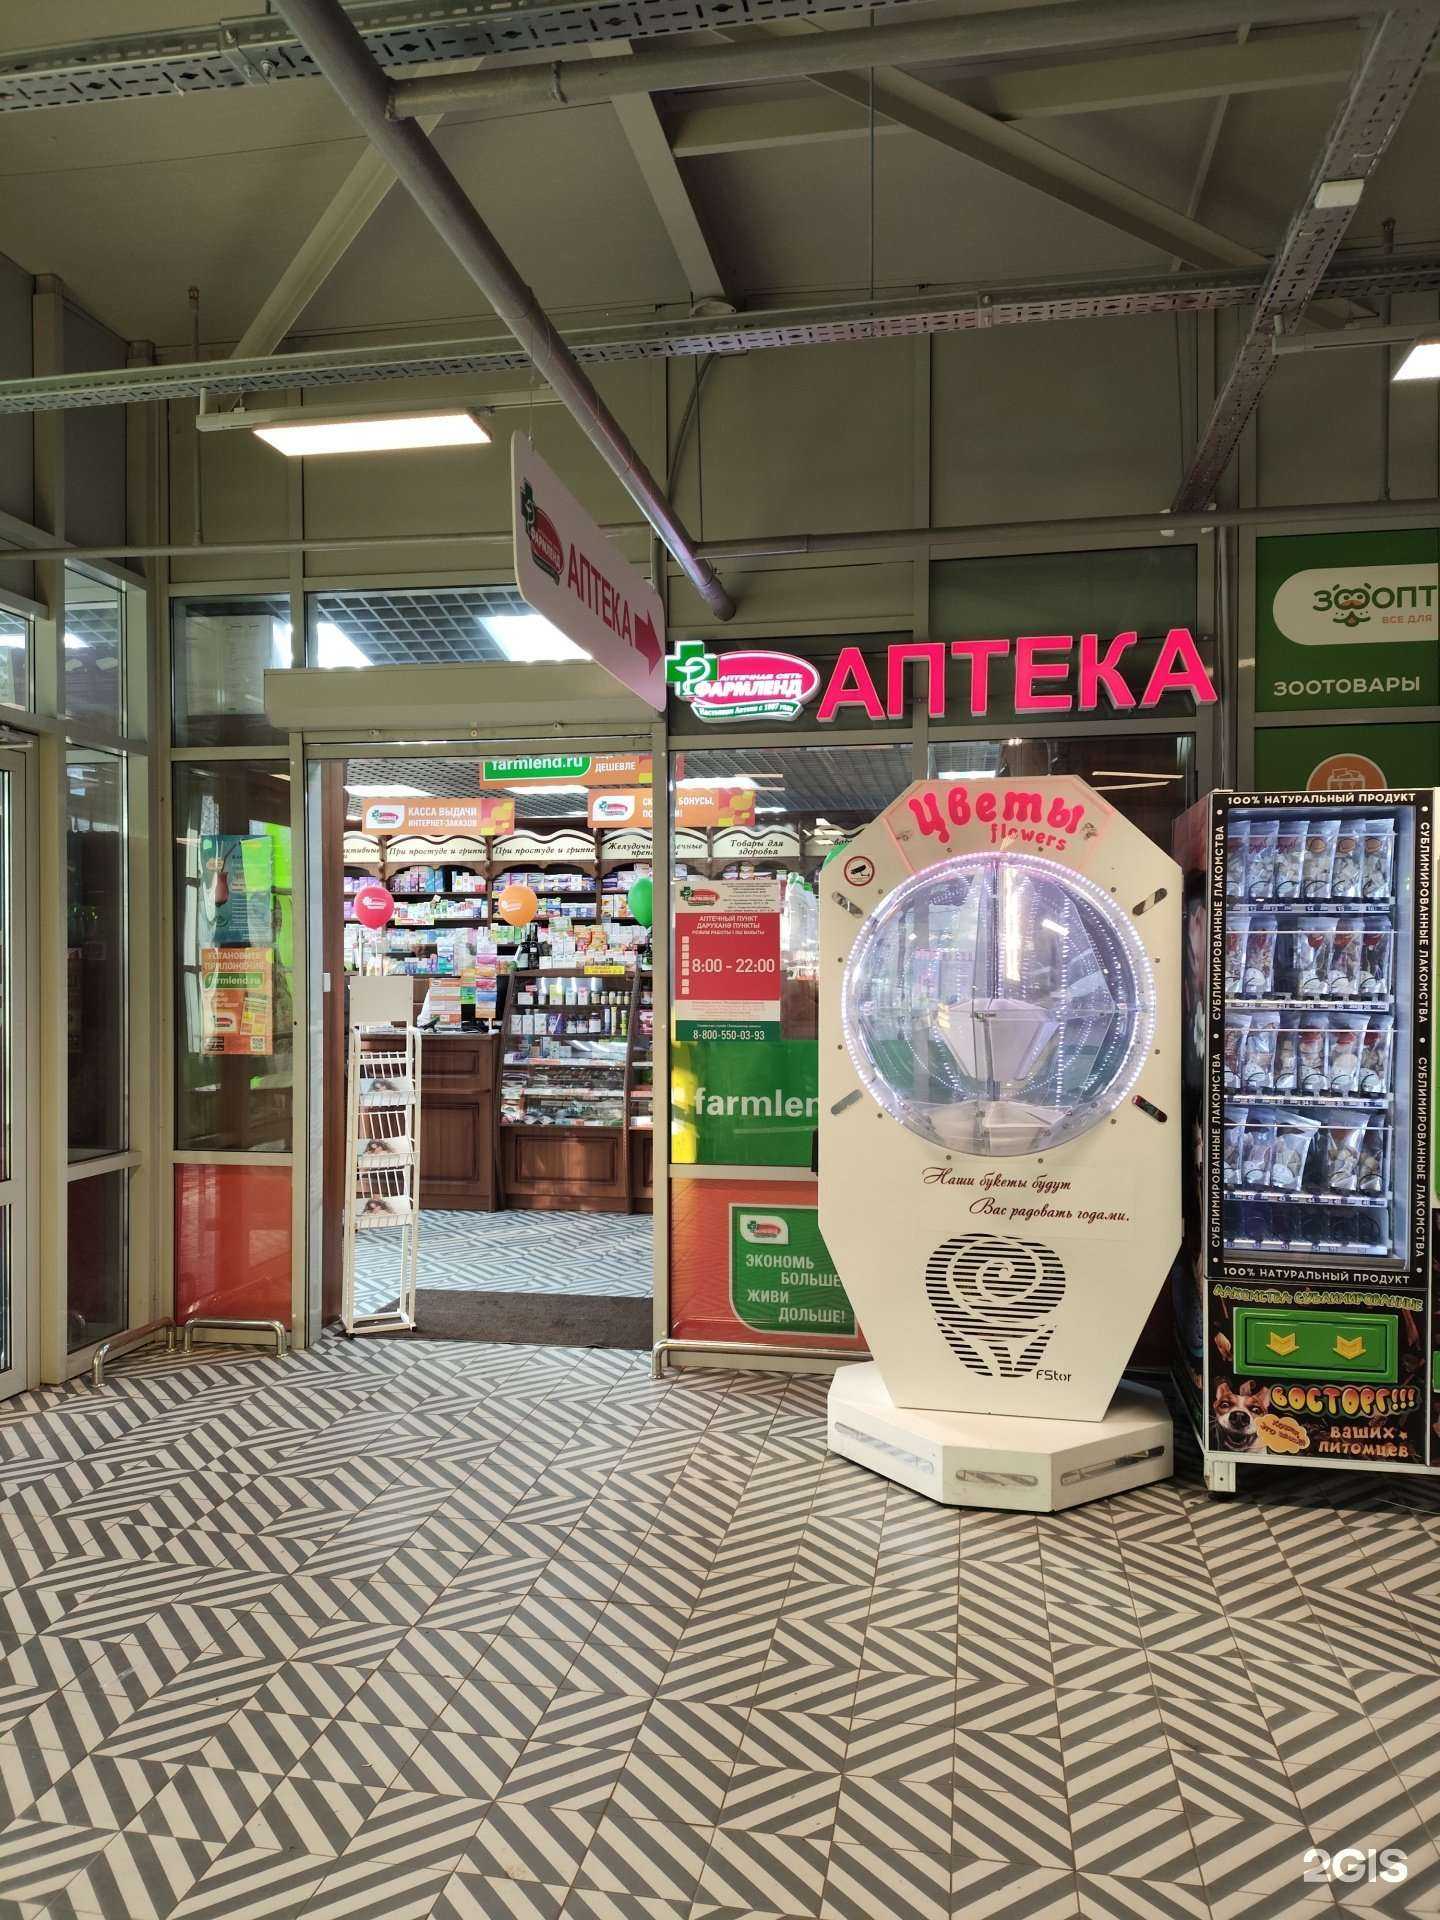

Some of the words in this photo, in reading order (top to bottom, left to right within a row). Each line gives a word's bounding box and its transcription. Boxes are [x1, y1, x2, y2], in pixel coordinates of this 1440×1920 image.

[568, 543, 633, 646] АПТЕКА
[1407, 614, 1433, 625] ДЛЯ
[816, 628, 1218, 723] АПТЕКА
[694, 679, 803, 698] ФАРМЛЕНД
[1273, 676, 1420, 696] ЗООТОВАРЫ
[595, 762, 636, 773] ДЕШЕВЛЕ
[1228, 795, 1261, 805] 100%
[1265, 793, 1354, 804] НАТУРАЛЬНЫЙ
[1359, 793, 1416, 804] ПРОДУКТ
[408, 807, 437, 816] КАССА
[439, 807, 477, 816] ВЫДАЧИ
[908, 787, 1085, 843] Цветы
[731, 839, 764, 849] Товары
[767, 840, 784, 848] для
[989, 823, 1068, 852] flowers
[409, 848, 448, 858] простуде
[495, 847, 513, 857] При
[515, 846, 556, 857] простуде
[738, 848, 779, 857] здоровья
[1213, 826, 1225, 897] ЛАКОМСТВА
[1420, 823, 1430, 945] СУБЛИМИРОВАННЫЕ
[699, 914, 735, 922] АПТЕЧНЫЙ
[692, 958, 723, 973] 8:00
[735, 958, 775, 973] 22:00
[1213, 900, 1223, 1021] СУБЛИМИРОВАННЫЕ
[1418, 948, 1429, 1023] ЛАКОМСТВА
[692, 1030, 765, 1041] 8-800-550-03-93
[1213, 1053, 1221, 1125] ЛАКОМСТВА
[1416, 1057, 1427, 1180] СУБЛИМИРОВАННЫЕ
[921, 1168, 976, 1187] Наши
[979, 1173, 1027, 1191] букеты
[1031, 1174, 1072, 1194] будут
[1211, 1128, 1221, 1248] СУБЛИМИРОВАННЫЕ
[968, 1197, 1007, 1216] Вас
[1009, 1203, 1073, 1222] радовать
[1076, 1208, 1131, 1223] годами.
[1415, 1184, 1425, 1257] ЛАКОМСТВА
[746, 1254, 815, 1270] ЭКОНОМЬ
[1223, 1267, 1255, 1277] 100%
[1260, 1268, 1349, 1282] НАТУРАЛЬНЫЙ
[1353, 1273, 1410, 1284] ПРОДУКТ
[747, 1289, 789, 1303] ЖИВИ
[778, 1307, 846, 1324] ДОЛЬШЕ!
